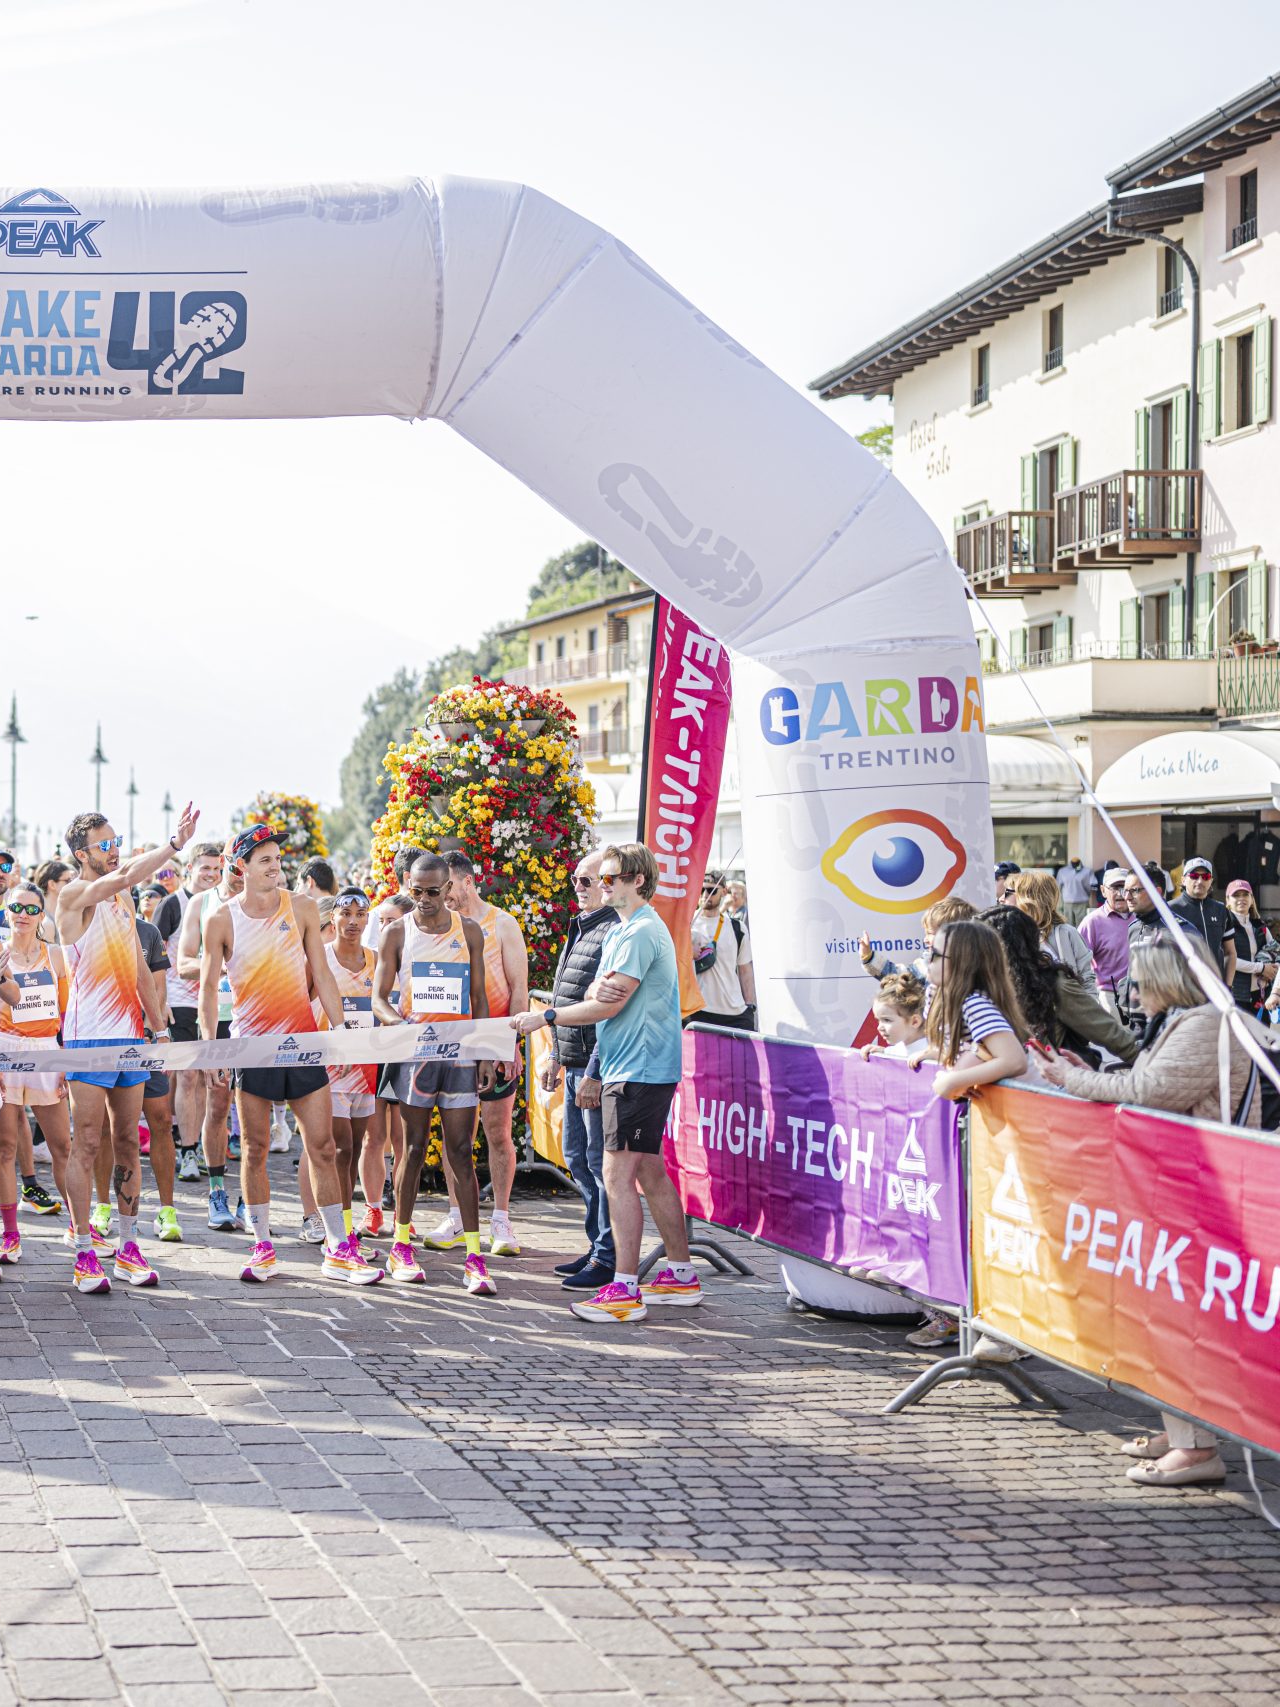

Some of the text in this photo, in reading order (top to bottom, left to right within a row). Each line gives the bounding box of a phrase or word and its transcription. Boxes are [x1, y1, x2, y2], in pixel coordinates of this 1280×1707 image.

[106, 290, 248, 395] 42
[34, 386, 132, 396] RUNNING
[759, 676, 985, 745] GARDA
[655, 629, 721, 899] EAK-TAICHI
[819, 746, 956, 770] TRENTINO
[1140, 754, 1175, 780] Lucia
[1186, 748, 1219, 776] Nico
[446, 993, 459, 1001] RUN
[140, 1059, 165, 1069] 42
[297, 1052, 322, 1064] 42
[436, 1042, 461, 1058] 42
[10, 1062, 36, 1071] 42
[886, 1173, 942, 1221] PEAK
[983, 1211, 1041, 1276] PEAK
[1060, 1201, 1192, 1303] PEAK
